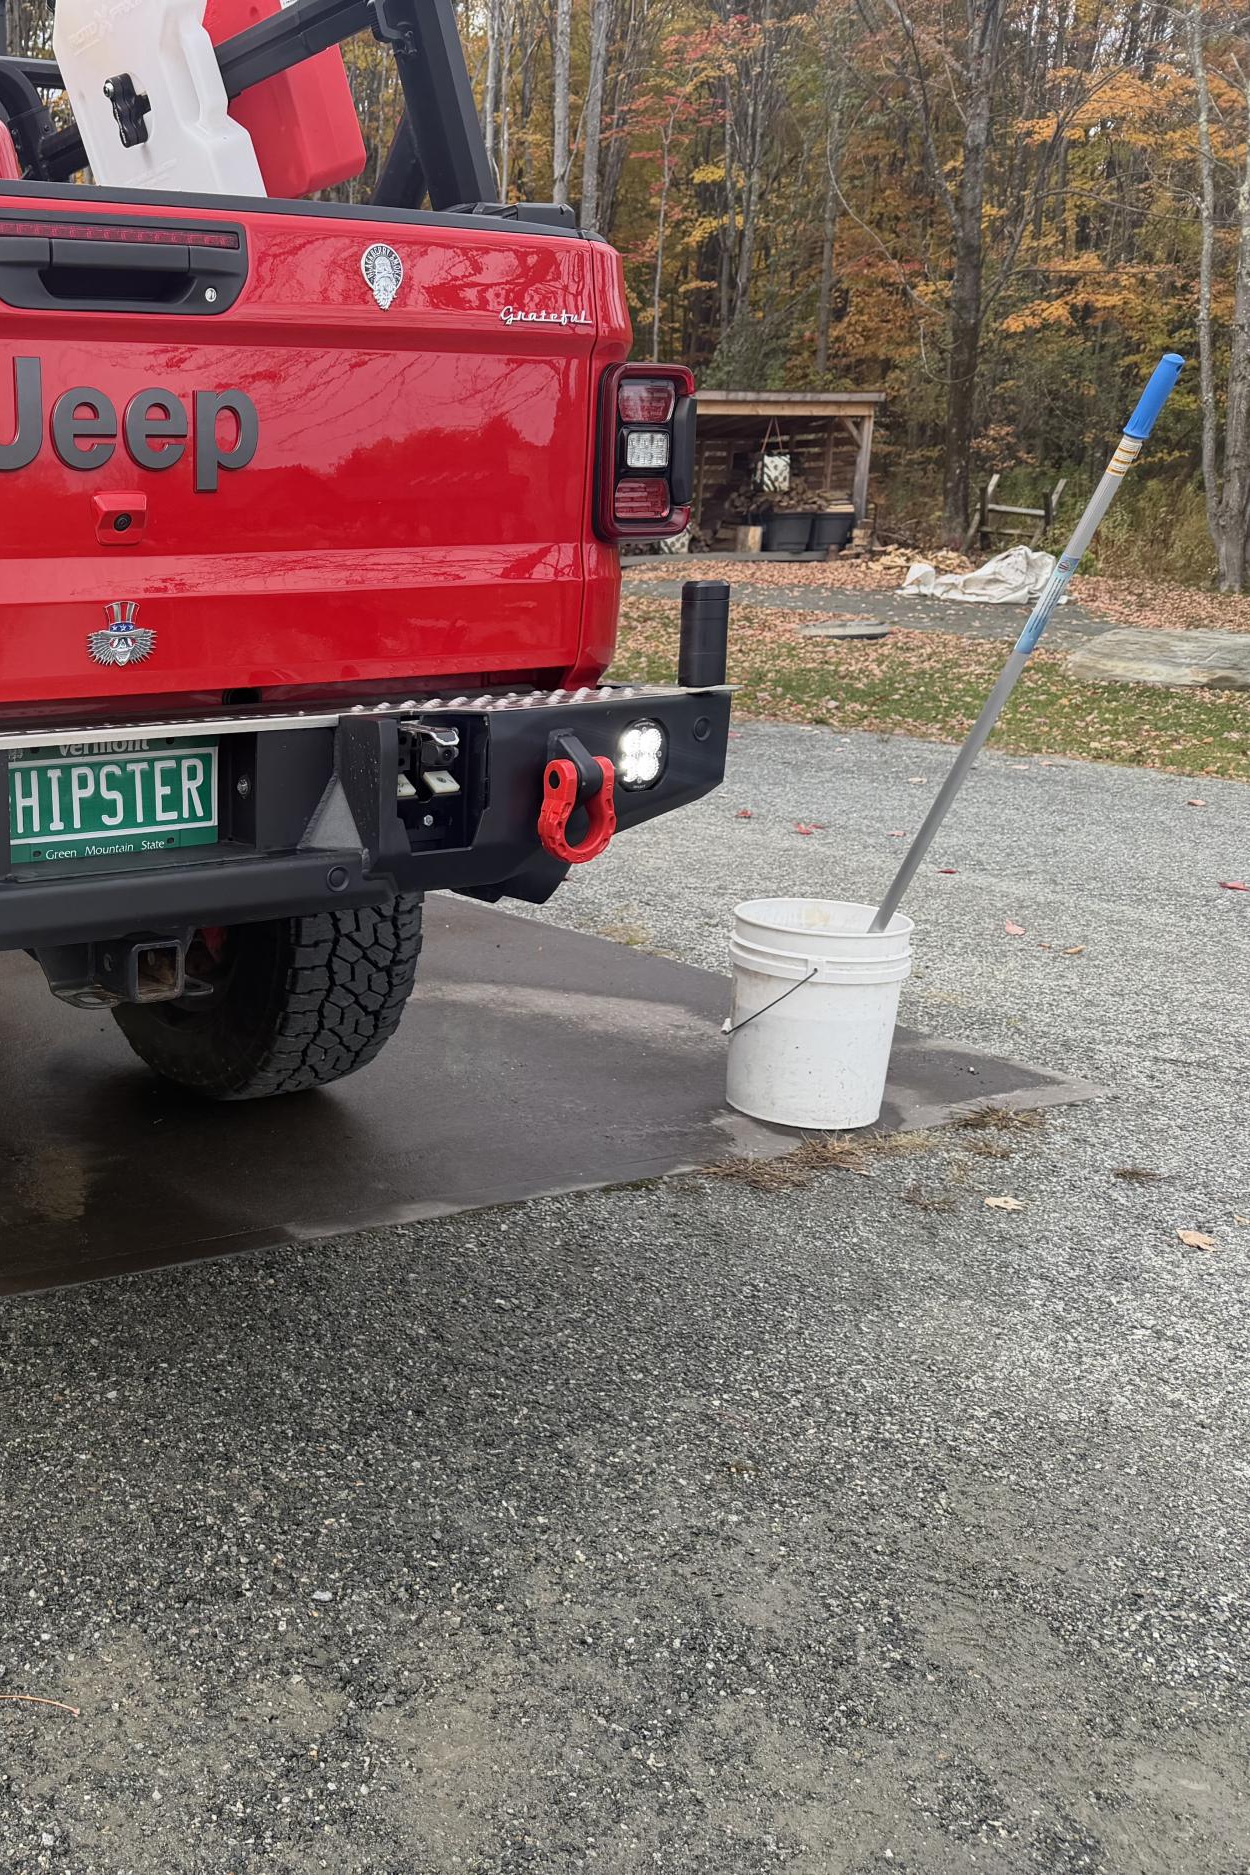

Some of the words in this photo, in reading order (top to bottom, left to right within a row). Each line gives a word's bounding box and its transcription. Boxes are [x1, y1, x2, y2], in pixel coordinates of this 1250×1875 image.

[499, 305, 593, 326] Grateful
[14, 757, 204, 833] HIPSTER
[45, 849, 77, 860] Green
[84, 842, 134, 857] Mountain
[141, 840, 165, 851] State
